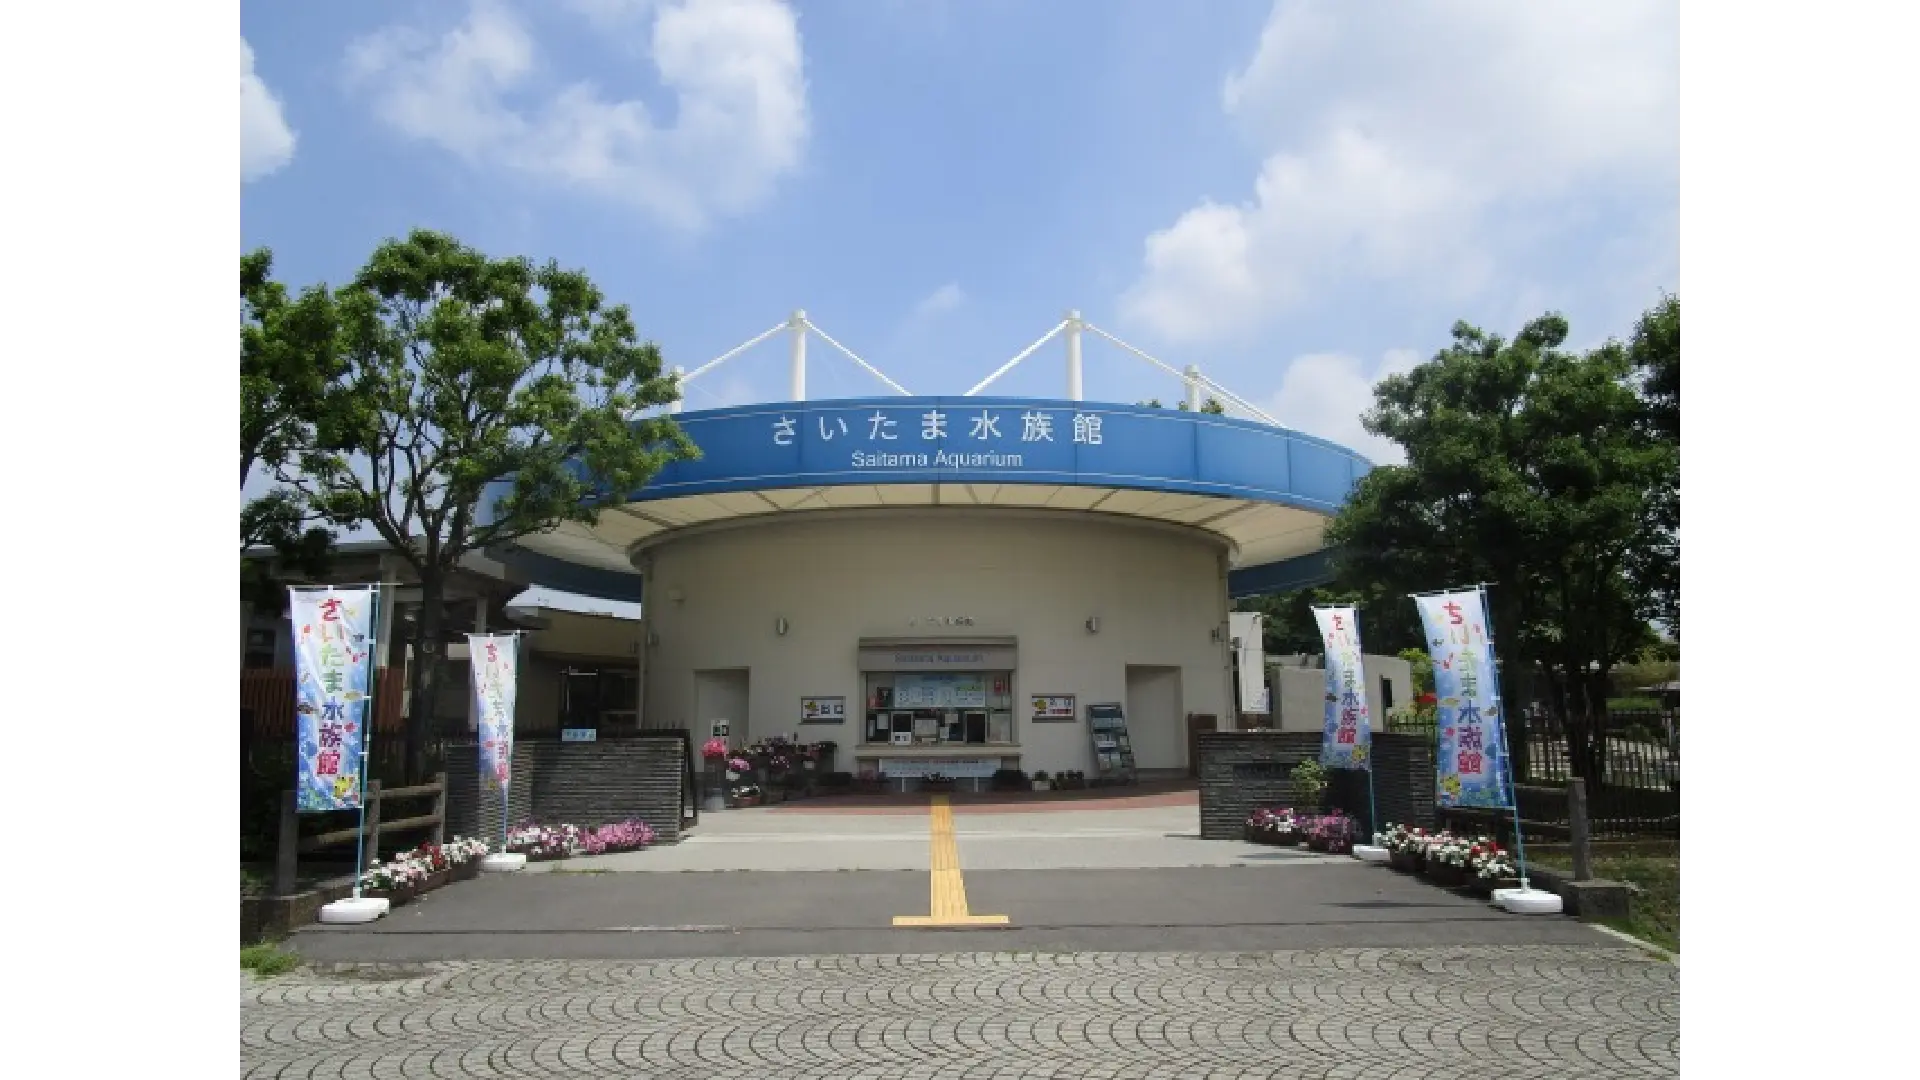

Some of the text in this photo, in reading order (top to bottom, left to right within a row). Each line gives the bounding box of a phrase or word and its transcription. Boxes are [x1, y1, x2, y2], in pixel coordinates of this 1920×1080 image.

[772, 409, 1103, 446] さいたま水族館
[851, 449, 1023, 469] Saitama Aquarium
[316, 598, 345, 775] さいたま水族館
[1442, 601, 1483, 775] さいたま水族館
